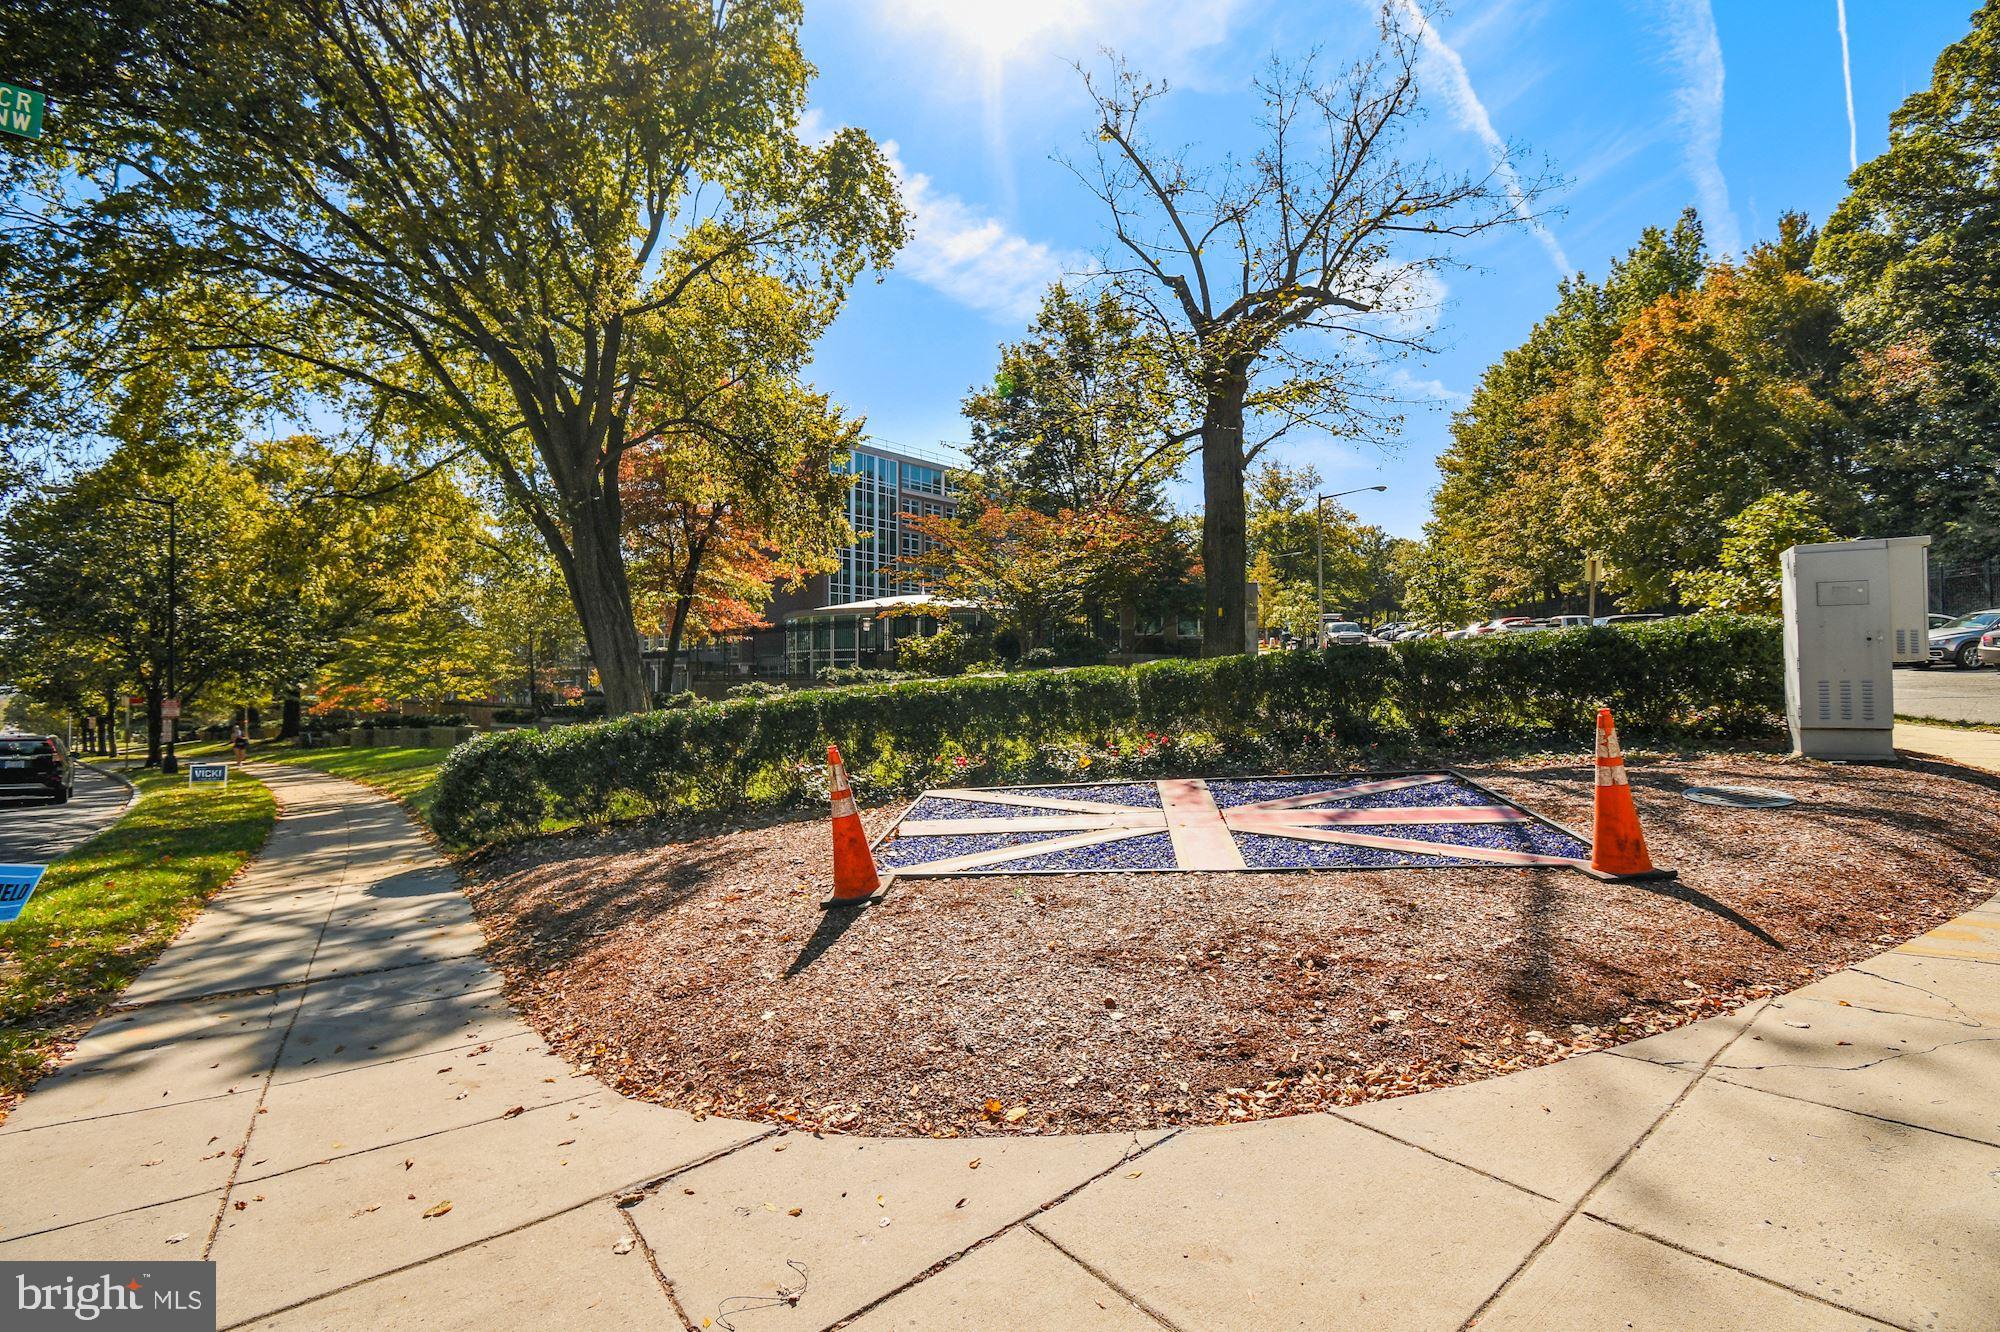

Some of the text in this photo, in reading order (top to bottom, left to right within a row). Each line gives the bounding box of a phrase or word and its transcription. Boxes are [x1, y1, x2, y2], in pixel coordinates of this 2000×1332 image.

[0, 87, 32, 113] CR
[0, 108, 31, 132] NW
[195, 769, 222, 778] VICKI
